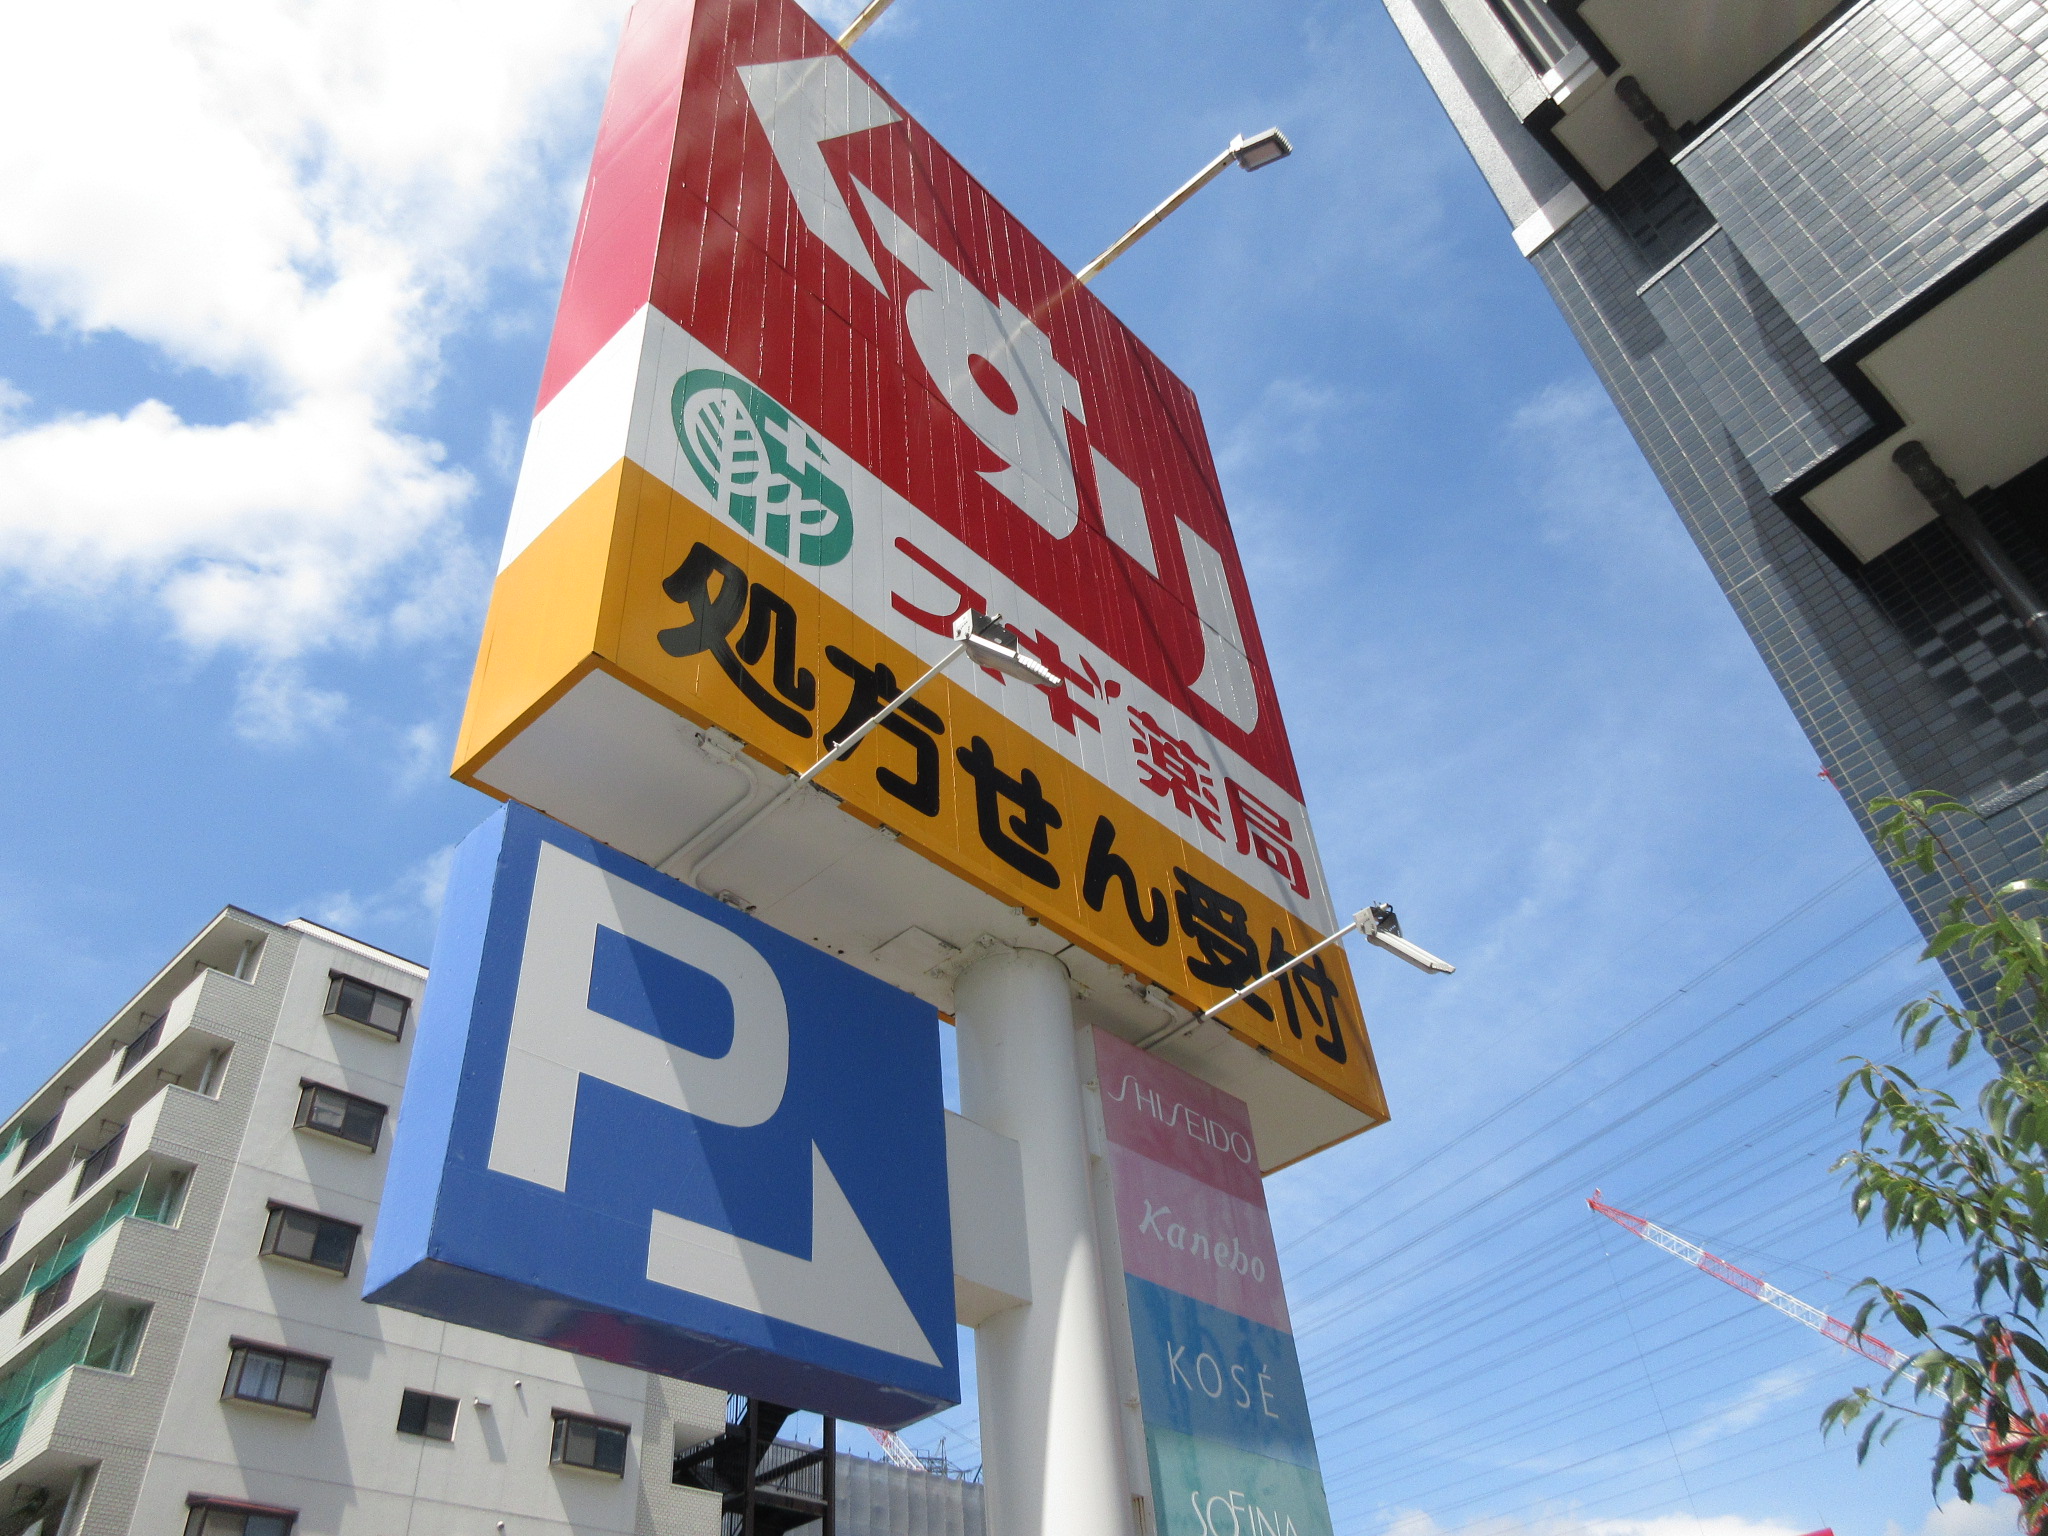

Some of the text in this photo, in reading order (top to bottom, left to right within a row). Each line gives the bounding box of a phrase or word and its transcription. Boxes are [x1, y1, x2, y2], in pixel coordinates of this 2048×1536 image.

[736, 54, 1259, 735] くすり
[657, 541, 1348, 1065] 処方せん受付
[890, 536, 1311, 900] スギ薬局
[487, 839, 790, 1193] P
[1108, 1074, 1252, 1164] SHISEIDO
[1138, 1198, 1266, 1284] Kanebo
[1165, 1339, 1280, 1420] KOSÉ
